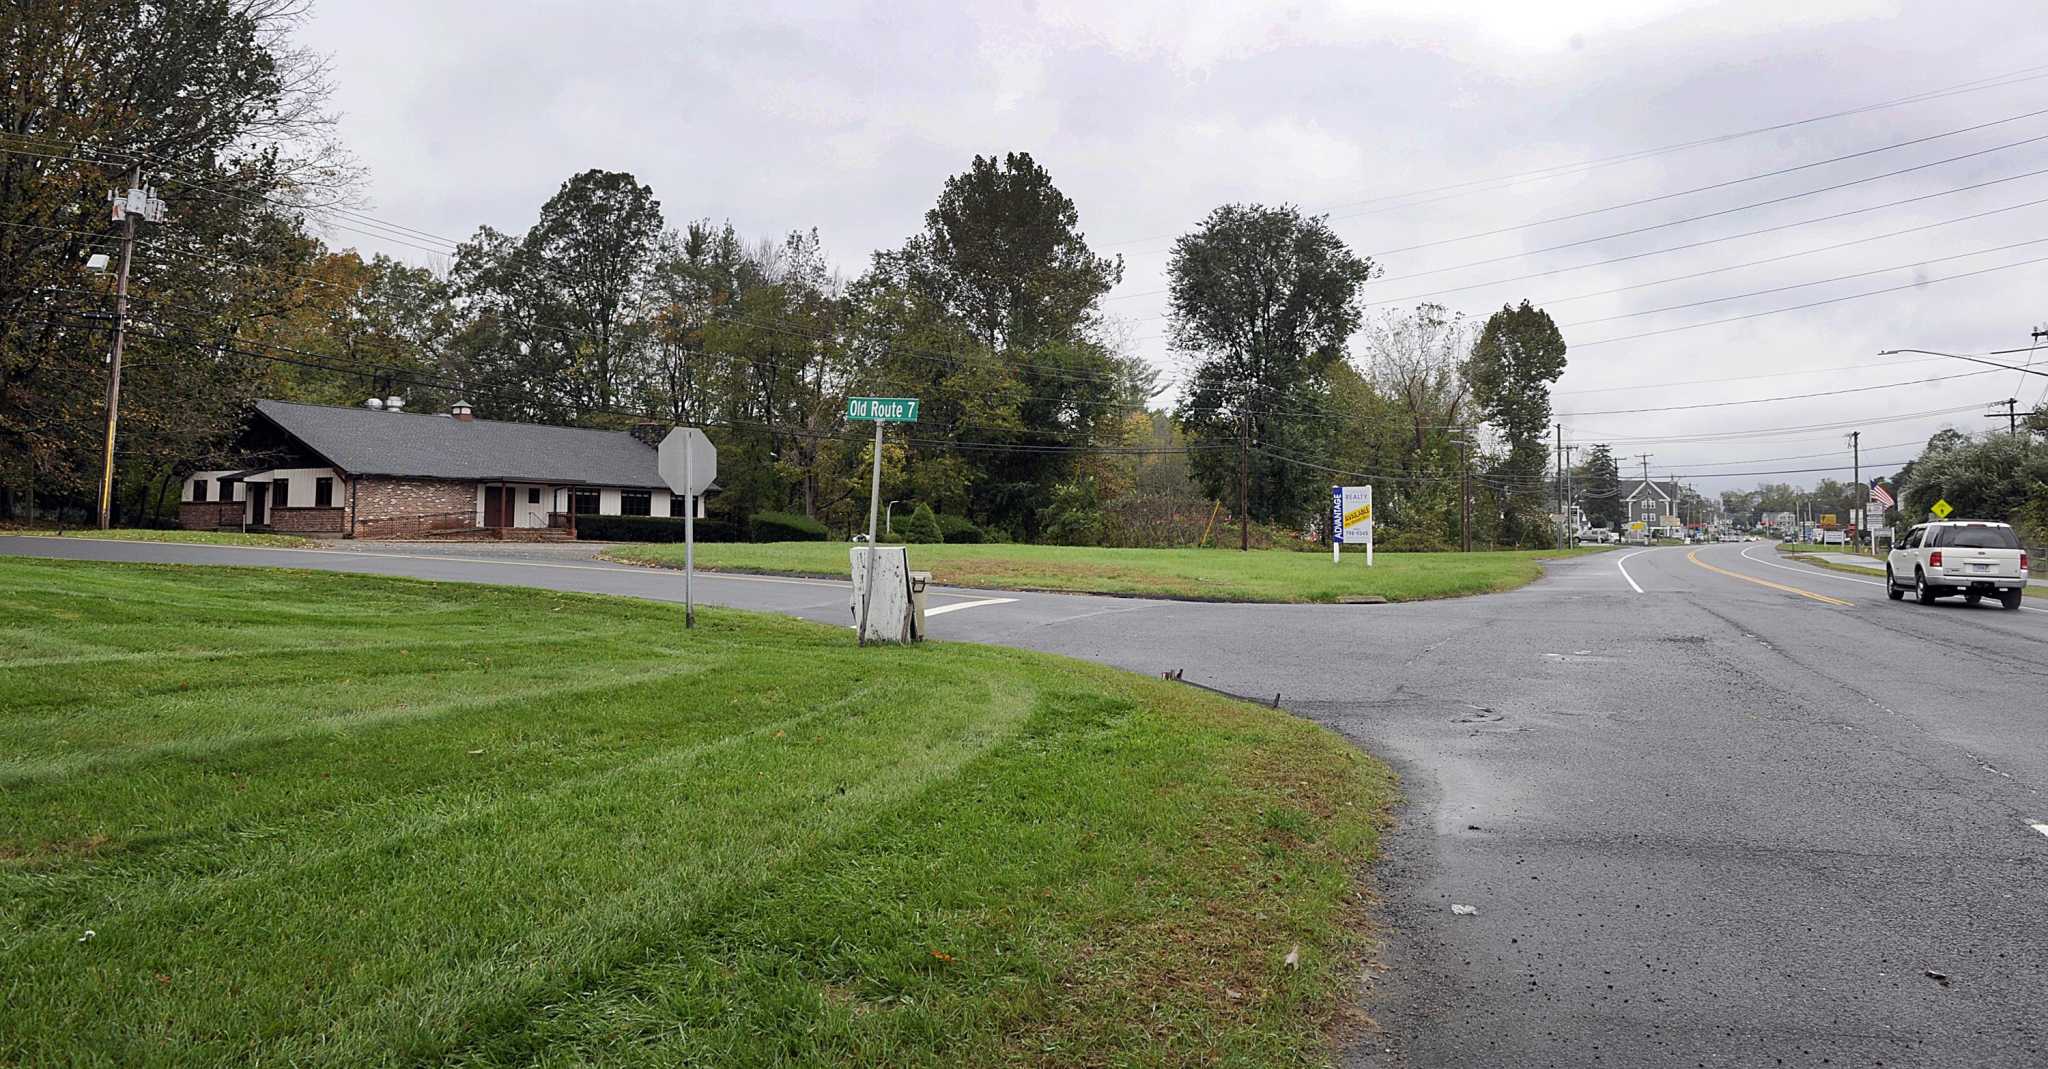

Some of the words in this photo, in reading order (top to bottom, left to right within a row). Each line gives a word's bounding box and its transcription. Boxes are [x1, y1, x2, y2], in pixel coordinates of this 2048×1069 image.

[850, 400, 867, 416] Old
[871, 401, 903, 417] Route
[907, 401, 916, 418] 7
[1333, 493, 1344, 540] ADVANTAGE
